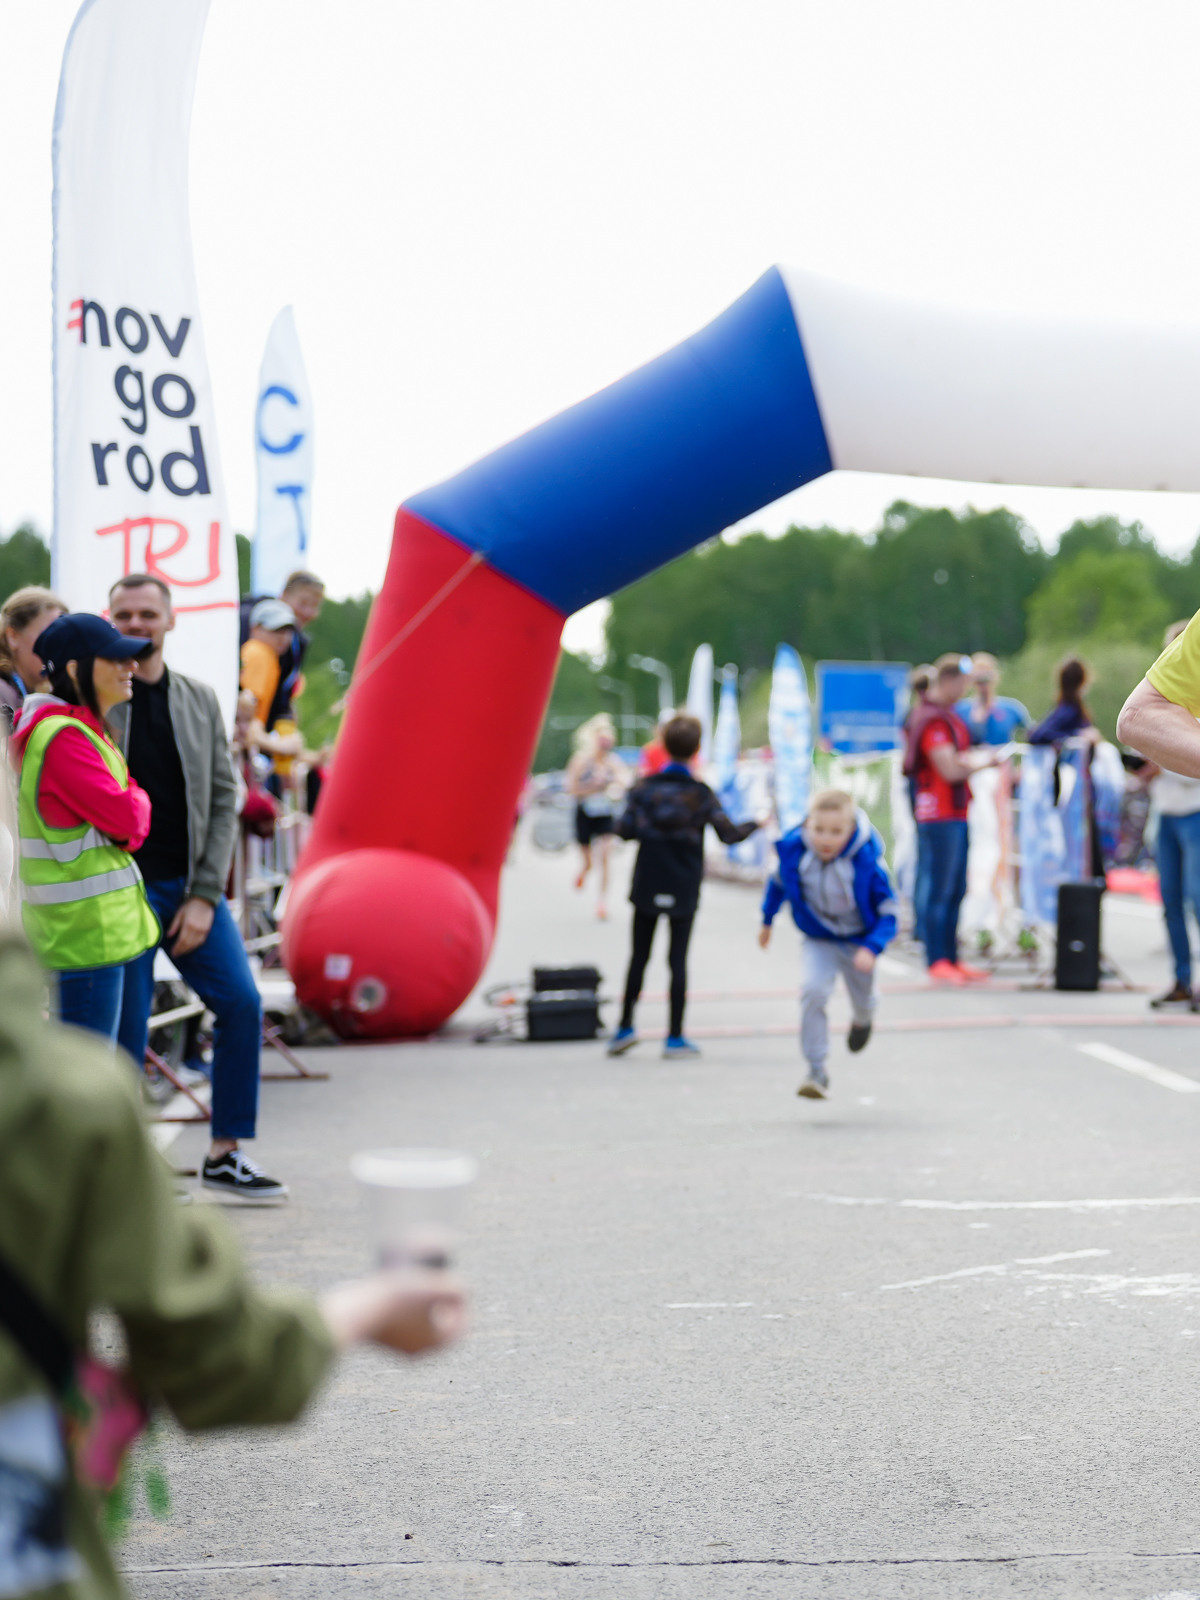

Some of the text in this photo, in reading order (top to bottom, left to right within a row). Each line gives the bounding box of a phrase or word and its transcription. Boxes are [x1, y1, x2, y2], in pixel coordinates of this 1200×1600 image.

[114, 364, 197, 435] go
[91, 424, 211, 498] rod
[95, 516, 222, 587] TRI
